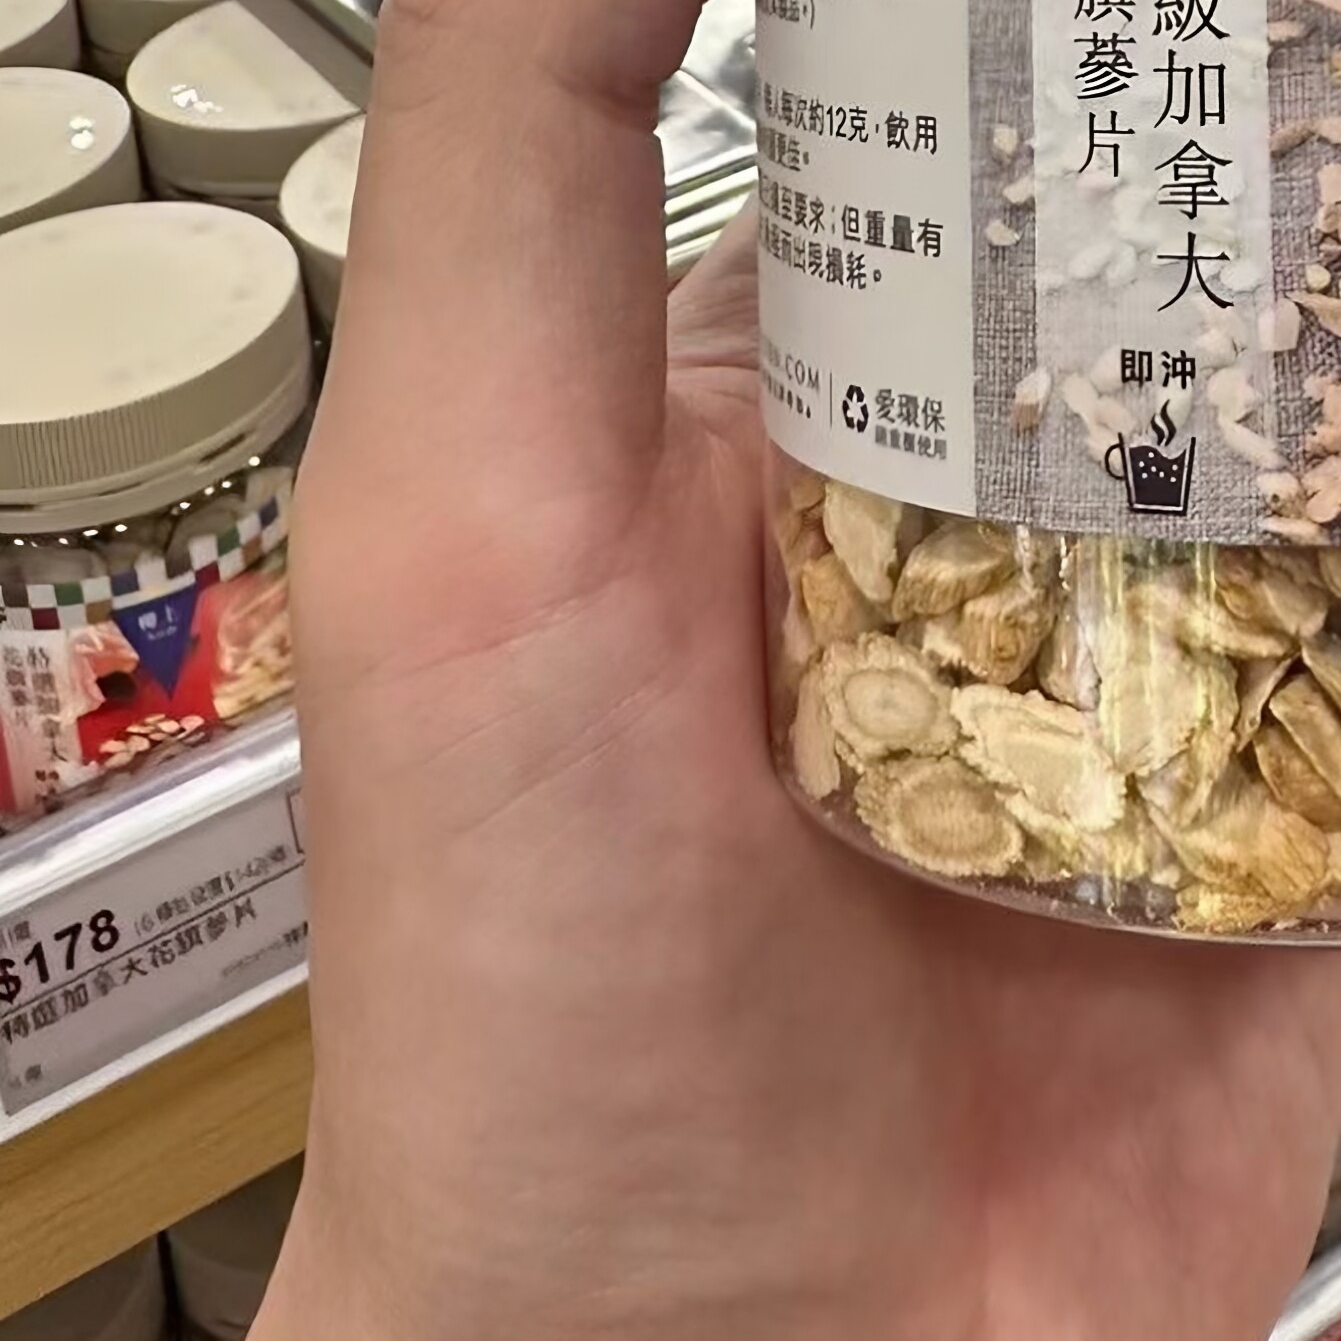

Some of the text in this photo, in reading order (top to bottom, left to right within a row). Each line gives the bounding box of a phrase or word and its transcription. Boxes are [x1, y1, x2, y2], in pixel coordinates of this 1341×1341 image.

[1120, 347, 1197, 390] 即沖
[875, 388, 946, 434] 愛環保
